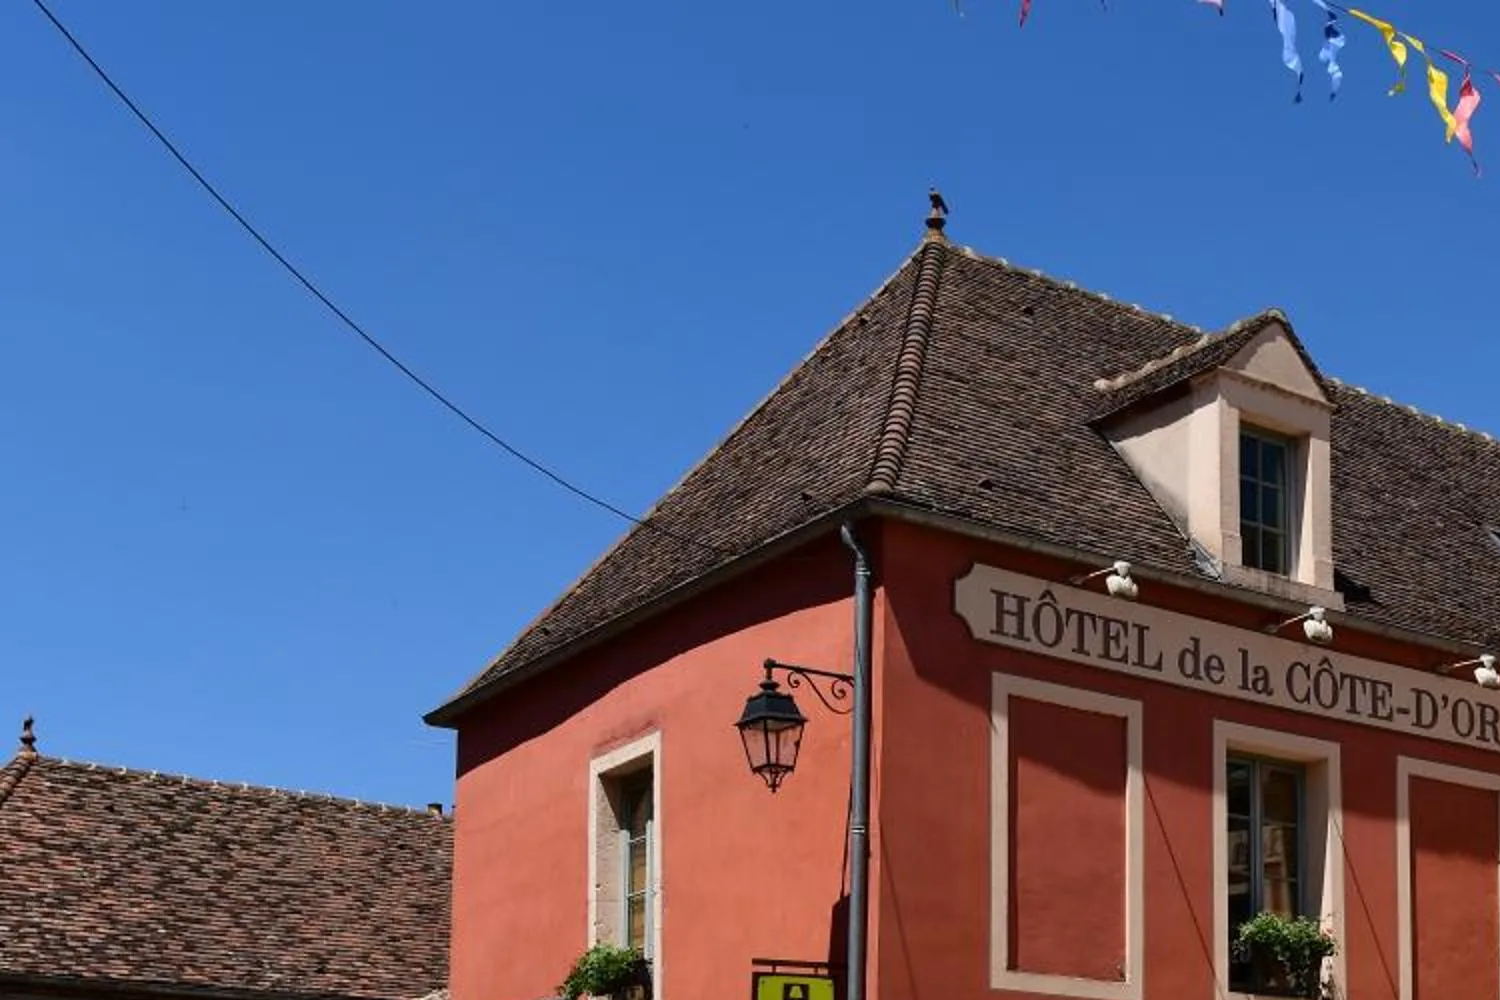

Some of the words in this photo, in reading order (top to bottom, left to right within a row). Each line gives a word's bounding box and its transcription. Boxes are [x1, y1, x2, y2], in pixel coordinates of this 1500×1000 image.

[989, 589, 1163, 671] HÔTEL
[1178, 637, 1225, 684] de
[1239, 648, 1274, 697] la
